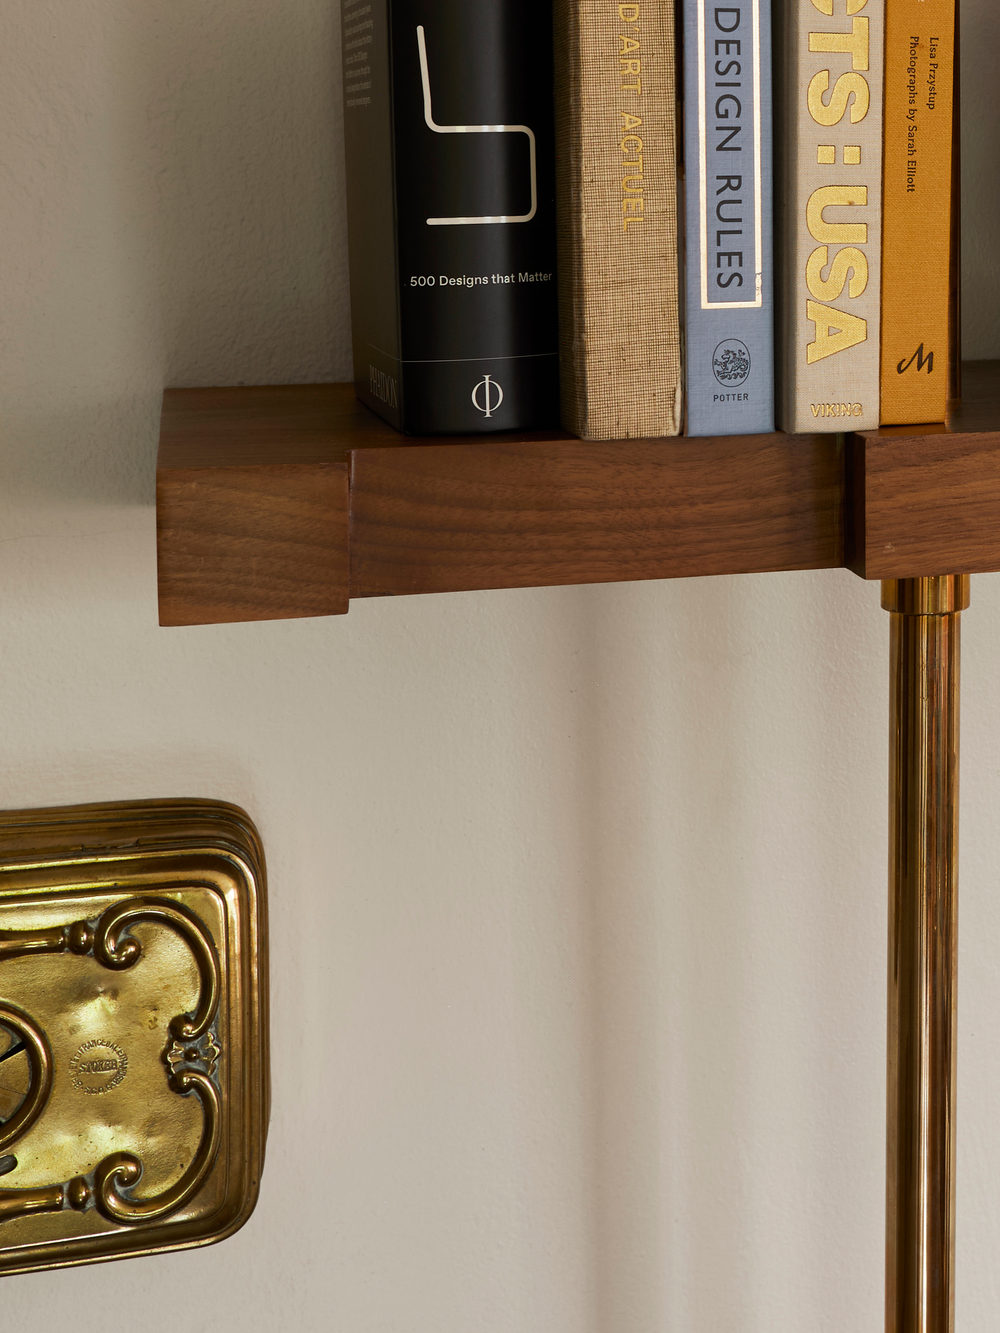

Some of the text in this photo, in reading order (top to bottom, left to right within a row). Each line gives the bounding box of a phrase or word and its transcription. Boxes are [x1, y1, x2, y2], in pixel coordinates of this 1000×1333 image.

[618, 3, 642, 95] D'ART
[714, 8, 742, 151] DESIGN
[926, 36, 940, 110] Lisa Przystup
[906, 37, 919, 193] Photographs by Sarah Elliott
[621, 111, 644, 232] ACTUEL
[716, 175, 743, 289] RULES
[409, 271, 552, 288] 500 Designs that Matter
[713, 392, 749, 403] POTTER
[810, 402, 863, 418] VIKING
